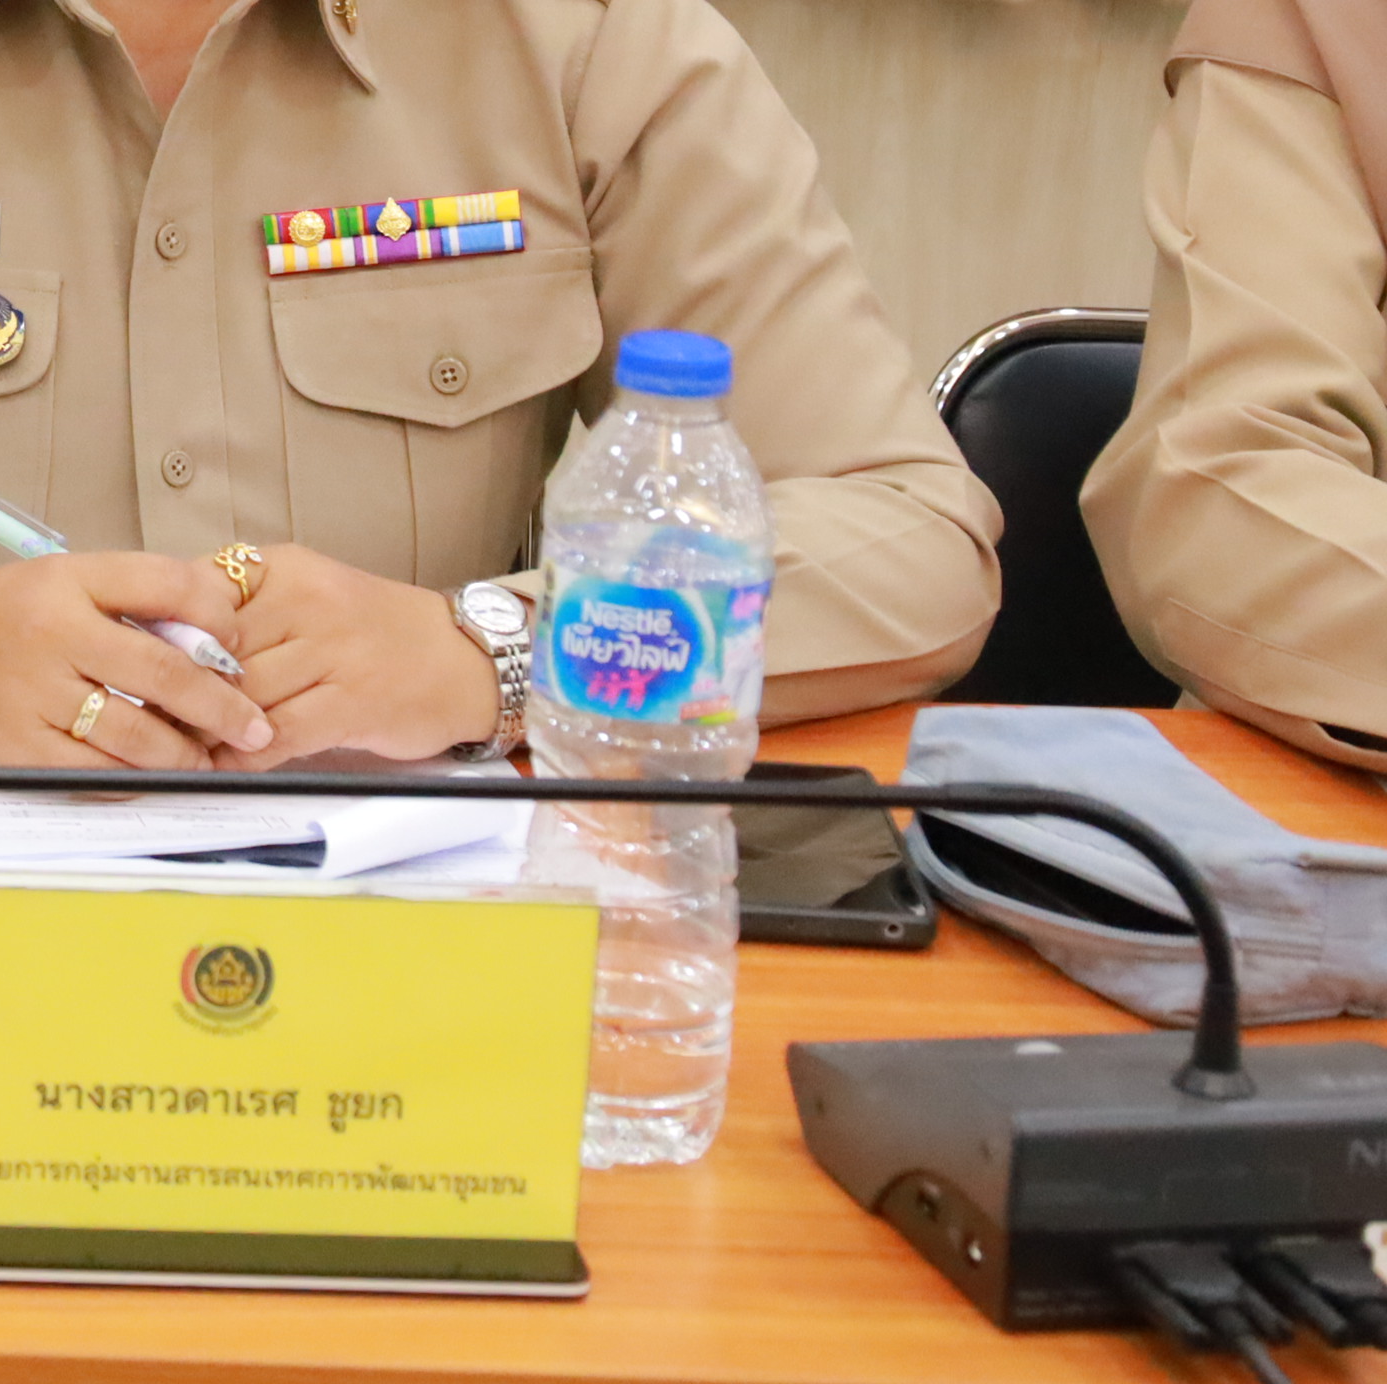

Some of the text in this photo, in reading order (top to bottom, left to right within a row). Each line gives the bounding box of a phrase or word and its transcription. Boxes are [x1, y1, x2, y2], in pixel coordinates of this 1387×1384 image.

[35, 1081, 299, 1118] นางสาวดาเรศ
